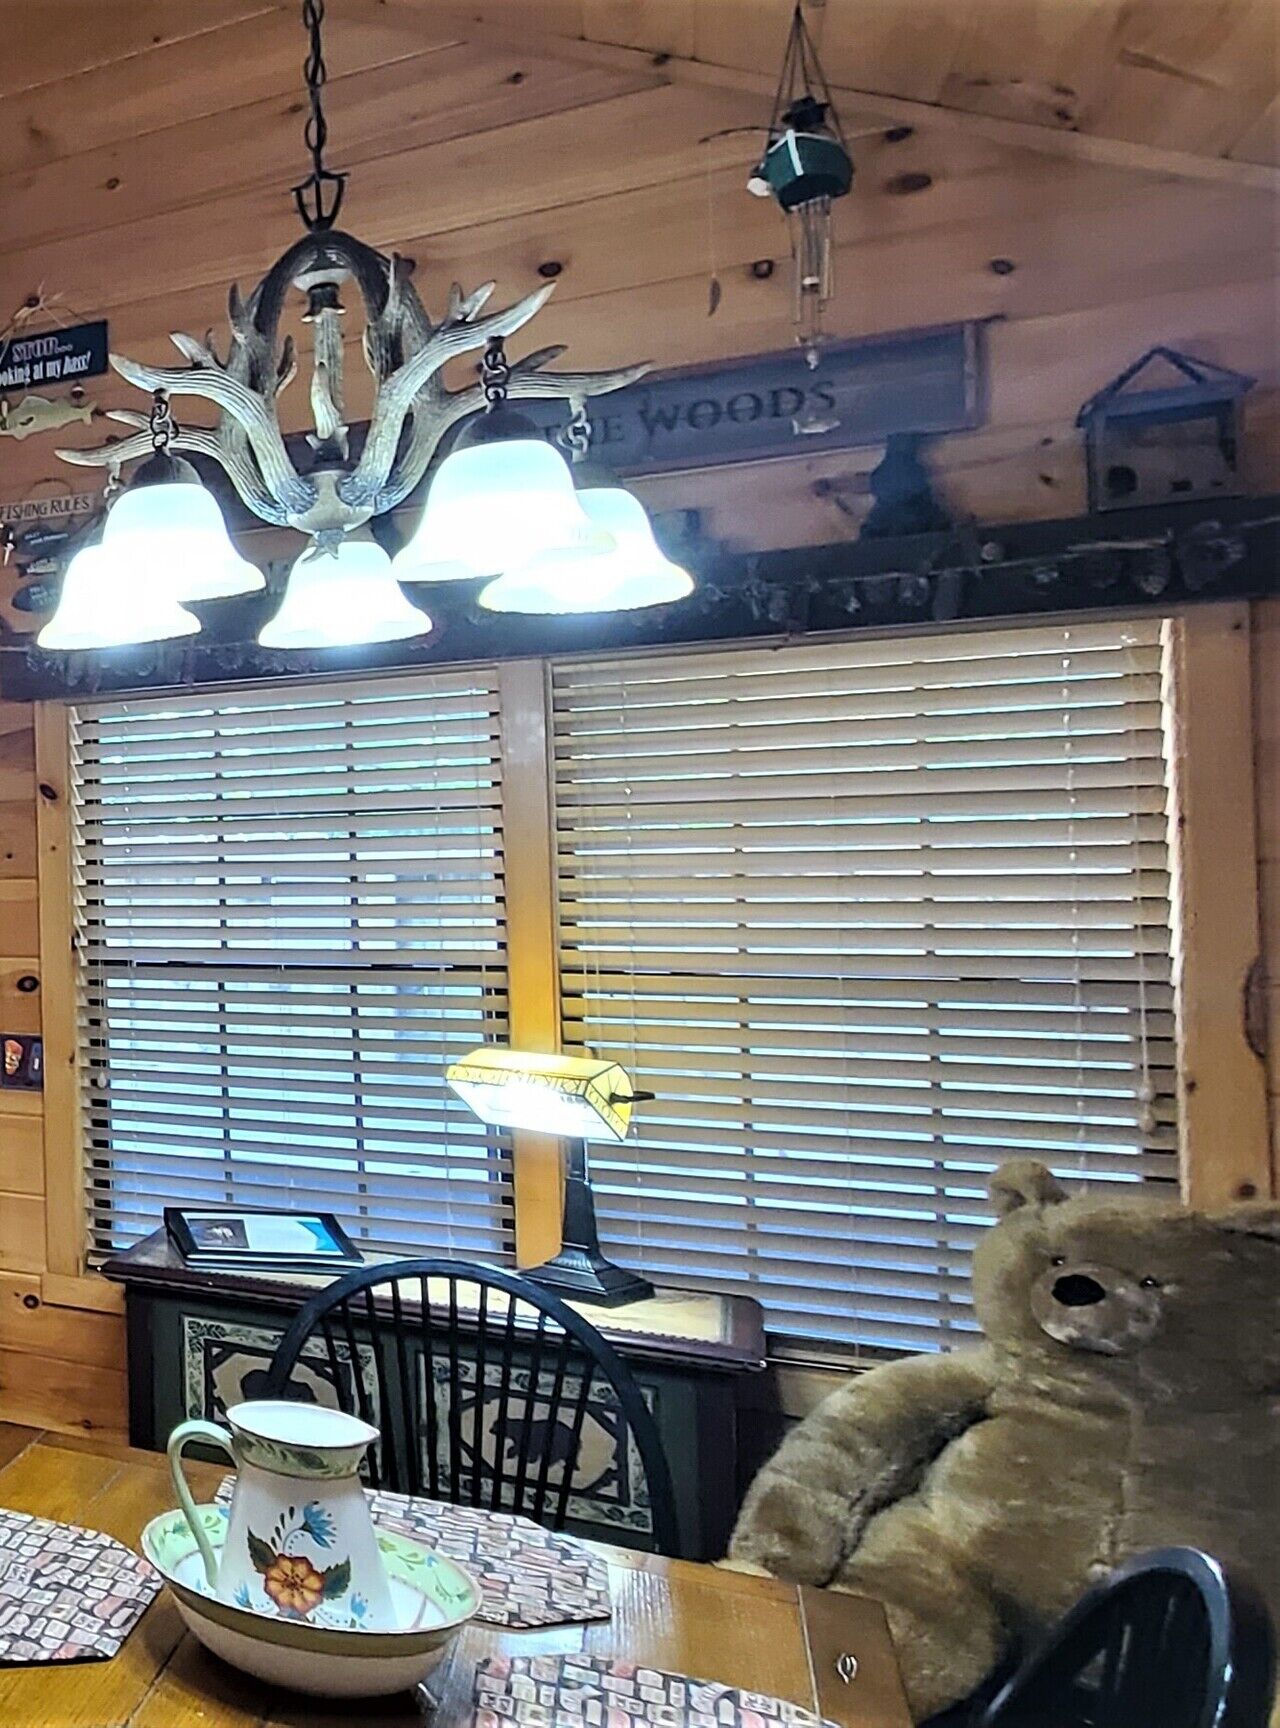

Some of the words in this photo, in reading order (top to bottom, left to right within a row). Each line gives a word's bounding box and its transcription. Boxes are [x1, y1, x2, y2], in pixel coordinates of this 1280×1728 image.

[32, 360, 44, 380] at
[46, 358, 62, 379] my
[638, 380, 836, 433] WOODS
[0, 502, 48, 520] FISHING
[50, 496, 90, 514] RULES
